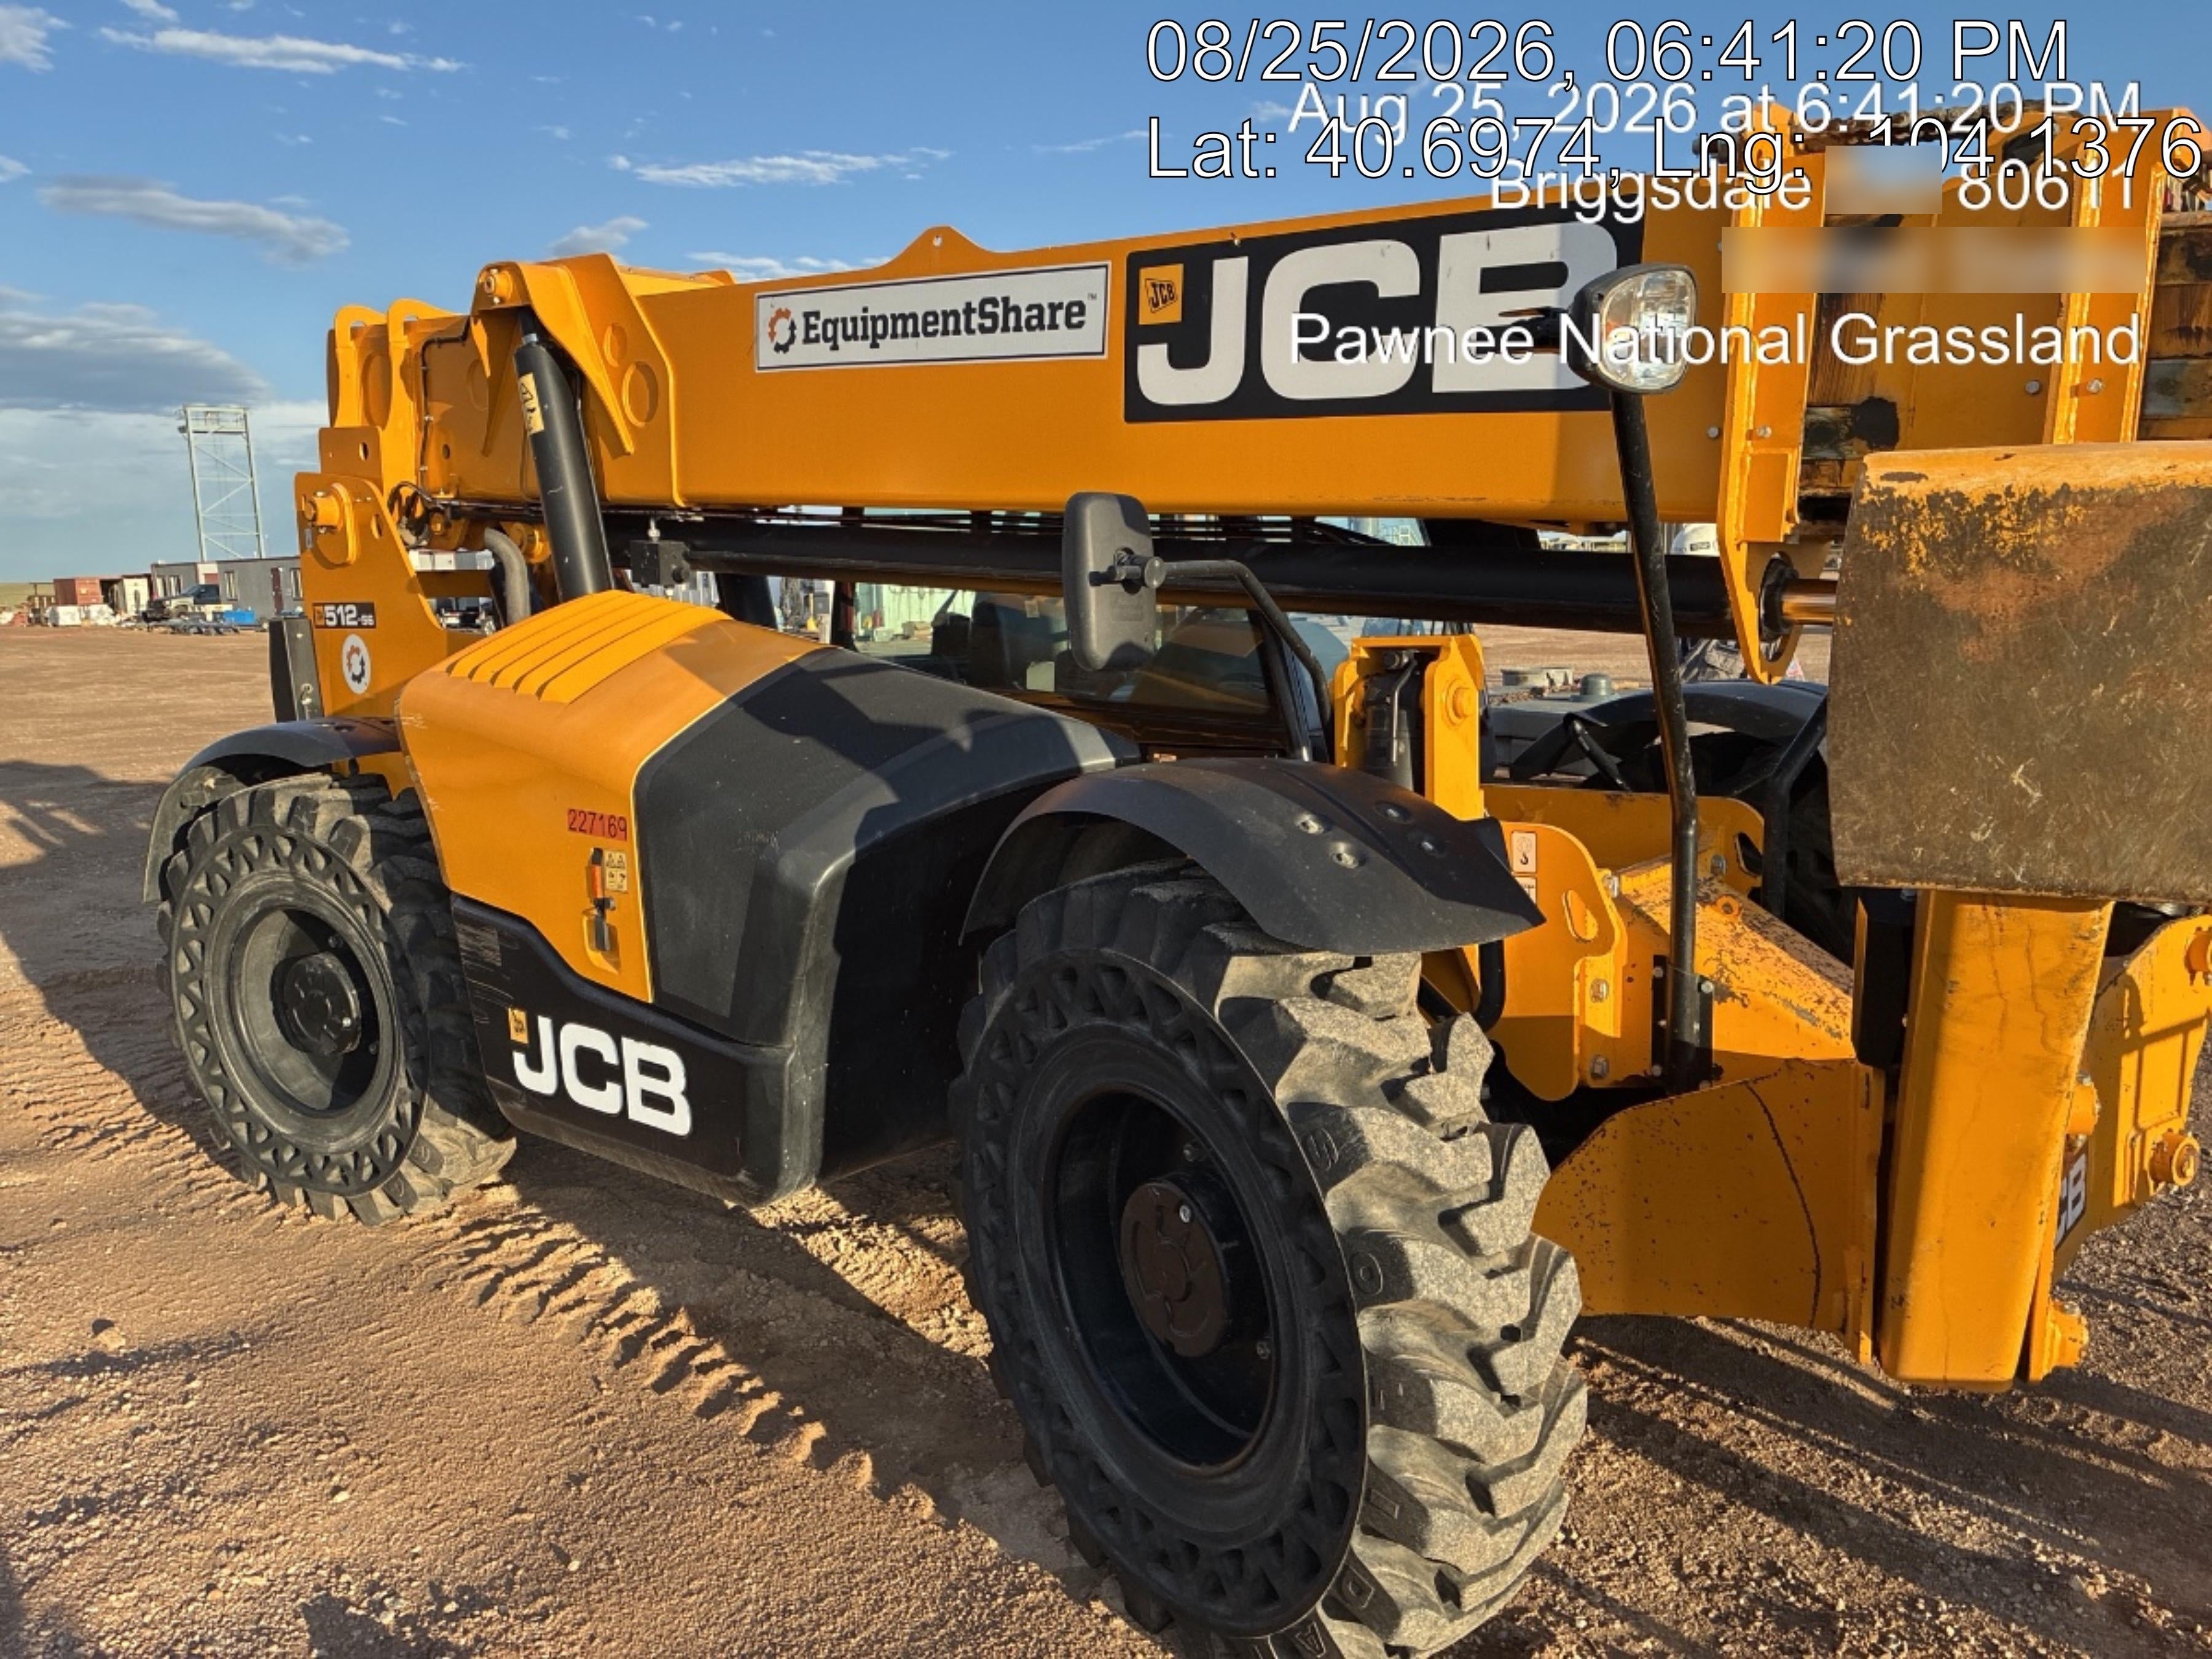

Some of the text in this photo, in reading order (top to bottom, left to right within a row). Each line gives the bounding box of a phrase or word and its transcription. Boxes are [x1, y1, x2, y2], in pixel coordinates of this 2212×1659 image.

[1137, 222, 1618, 406] JCB
[1150, 281, 1175, 309] JCB
[802, 296, 1086, 350] EquipmentShare
[568, 809, 627, 842] 227169
[512, 1014, 692, 1136] JCB
